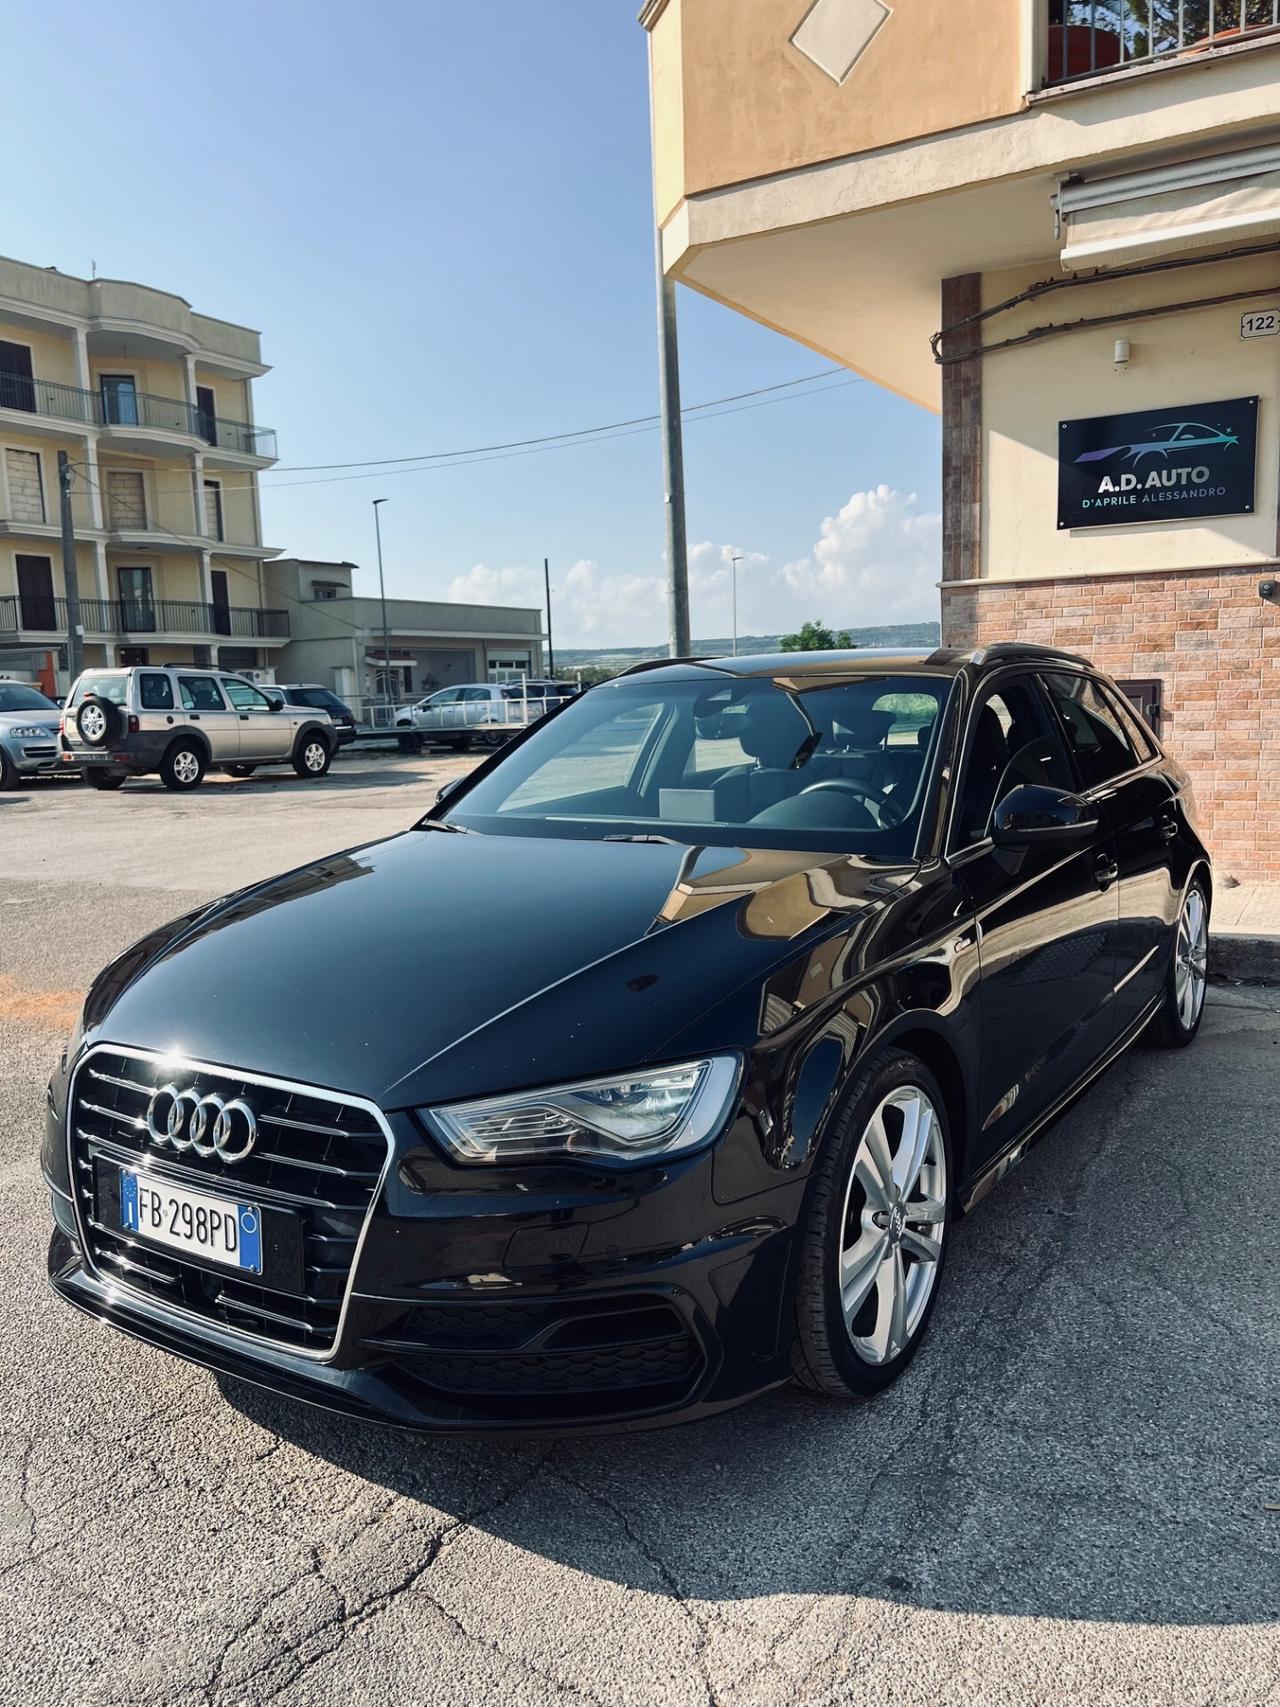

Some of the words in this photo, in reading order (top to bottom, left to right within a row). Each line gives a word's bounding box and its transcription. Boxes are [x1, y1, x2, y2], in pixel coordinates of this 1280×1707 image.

[1246, 315, 1275, 331] 122
[1097, 473, 1142, 493] A.D.
[1144, 465, 1210, 489] AUTO
[1082, 494, 1137, 509] D'APRILE
[1142, 486, 1226, 503] ALESSANDRO
